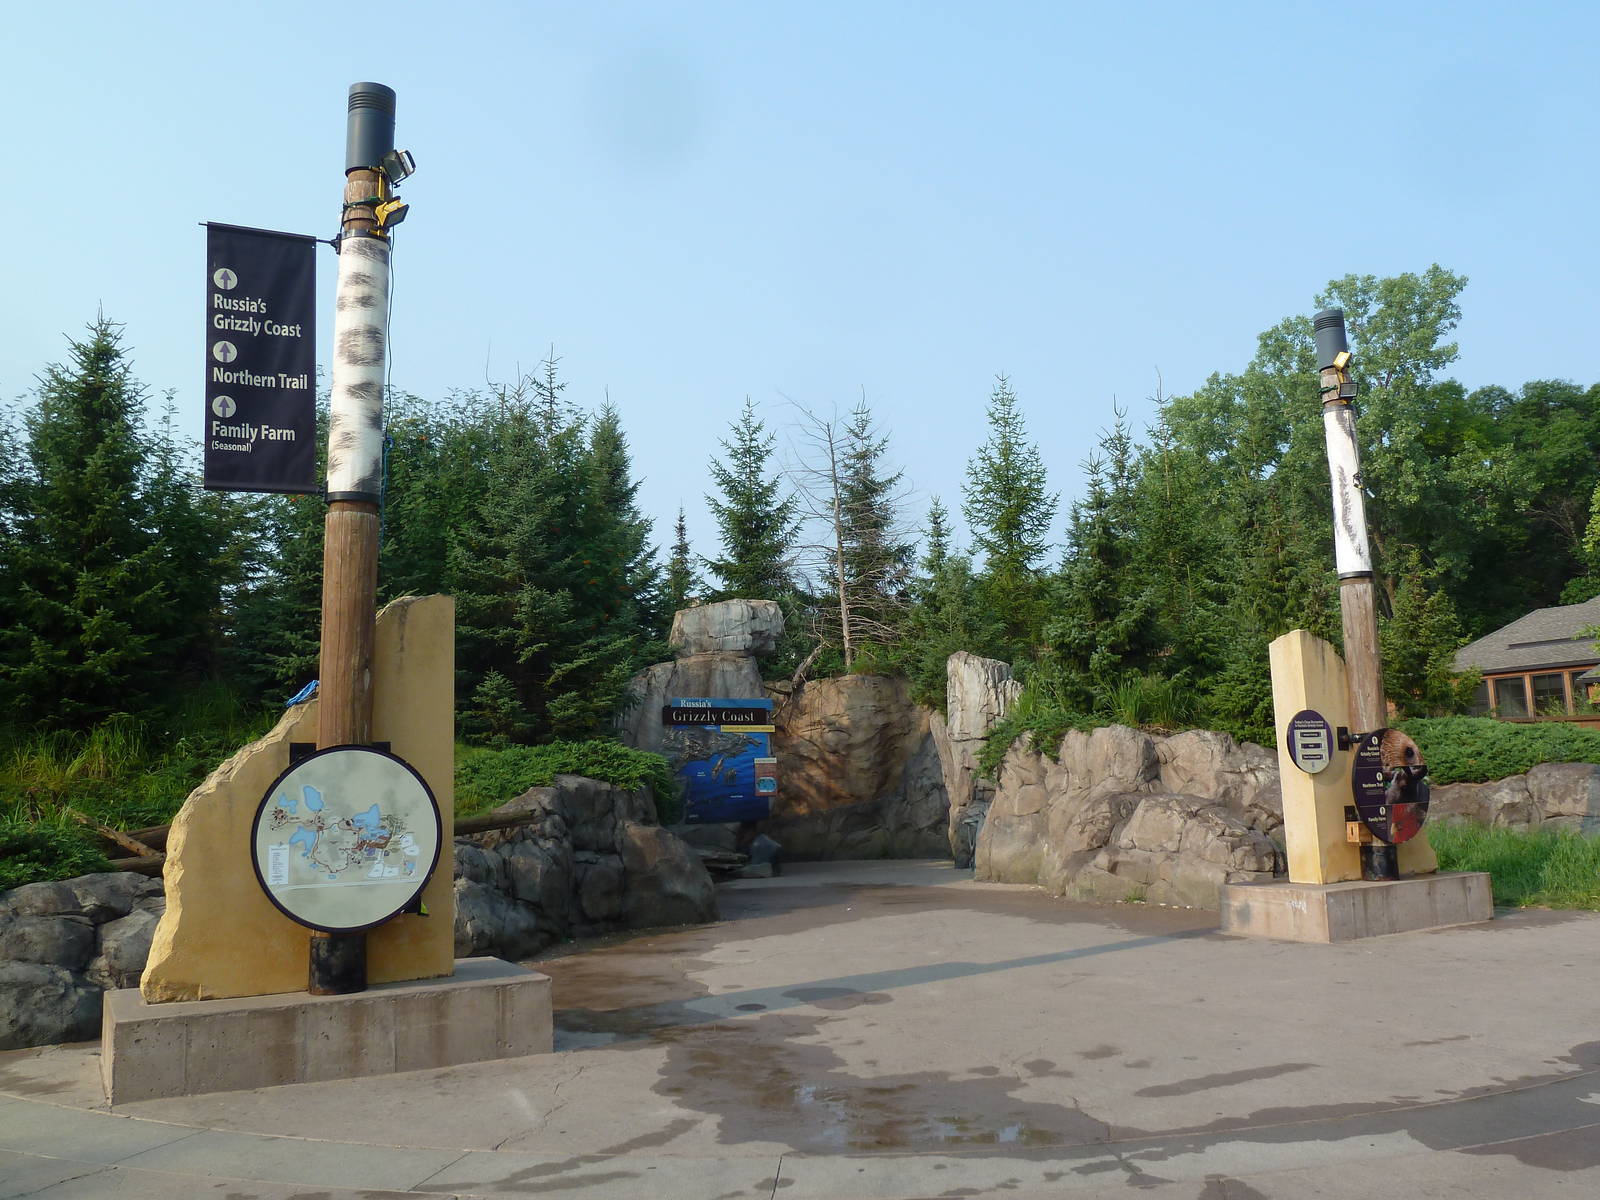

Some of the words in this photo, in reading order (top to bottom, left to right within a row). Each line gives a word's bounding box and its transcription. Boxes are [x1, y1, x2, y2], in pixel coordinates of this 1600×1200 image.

[213, 293, 267, 314] Russia's
[213, 313, 261, 337] Grizzly
[264, 320, 301, 338] Coast
[213, 367, 276, 388] Northern
[278, 373, 307, 390] Trail
[212, 420, 258, 443] Family
[261, 424, 295, 441] Farm
[211, 440, 252, 453] (Seasonal)
[680, 699, 712, 708] Russia's
[672, 710, 718, 723] Grizzly
[722, 711, 755, 722] Coast
